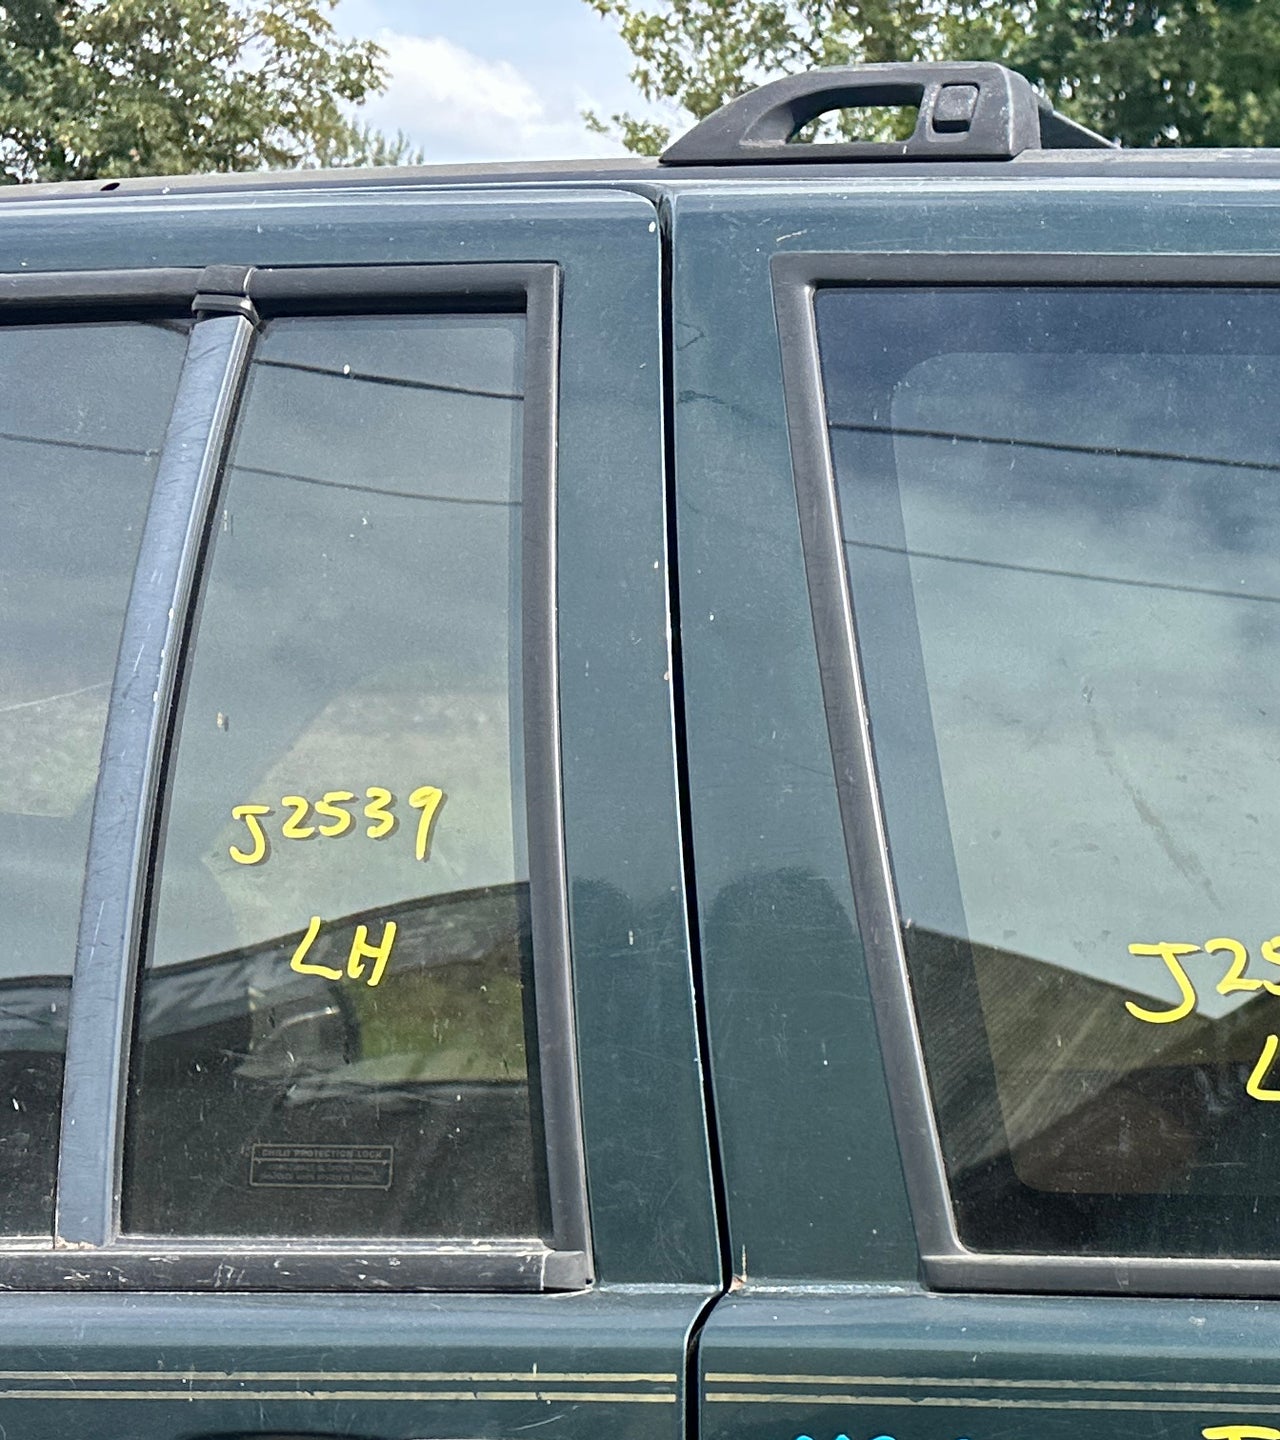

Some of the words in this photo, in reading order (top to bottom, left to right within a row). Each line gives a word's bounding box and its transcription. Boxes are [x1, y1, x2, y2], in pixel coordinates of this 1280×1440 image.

[228, 785, 443, 865] J2539
[289, 916, 397, 986] LH
[294, 1149, 353, 1158] PROTECTION
[357, 1150, 383, 1159] LOCK
